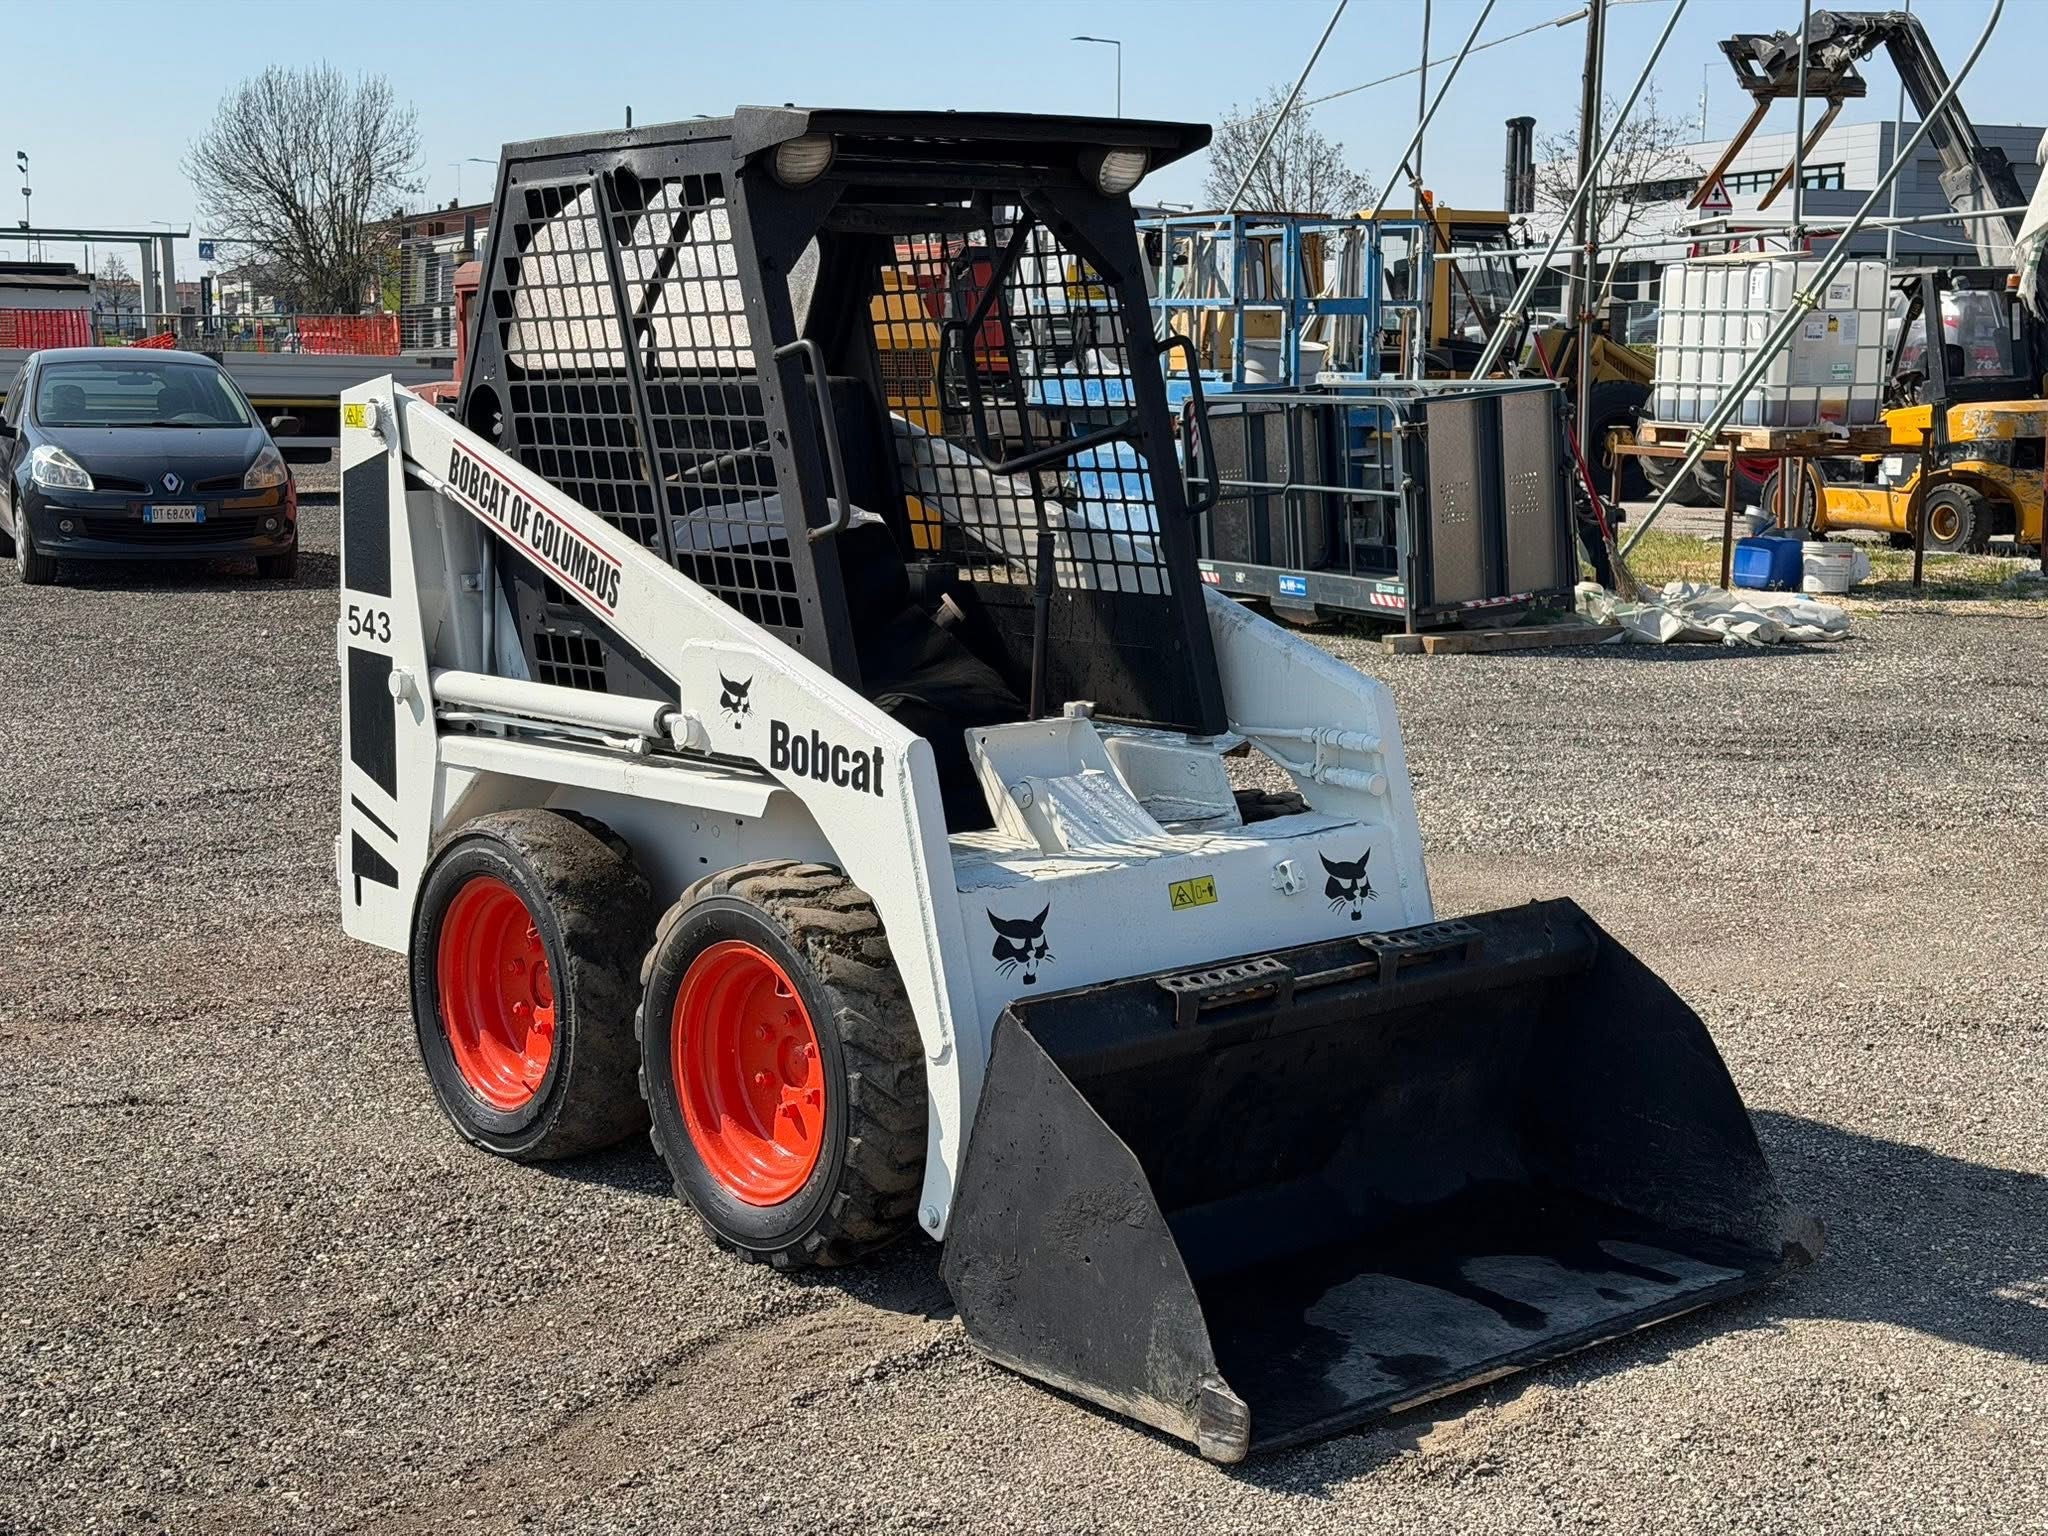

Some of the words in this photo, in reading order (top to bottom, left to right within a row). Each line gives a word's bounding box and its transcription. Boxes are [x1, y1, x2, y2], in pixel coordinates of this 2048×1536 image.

[448, 447, 511, 523] BOBCAT
[510, 494, 532, 539] OF
[531, 511, 621, 609] COLUMBUS
[348, 604, 391, 643] 543
[770, 719, 884, 797] Bobcat
